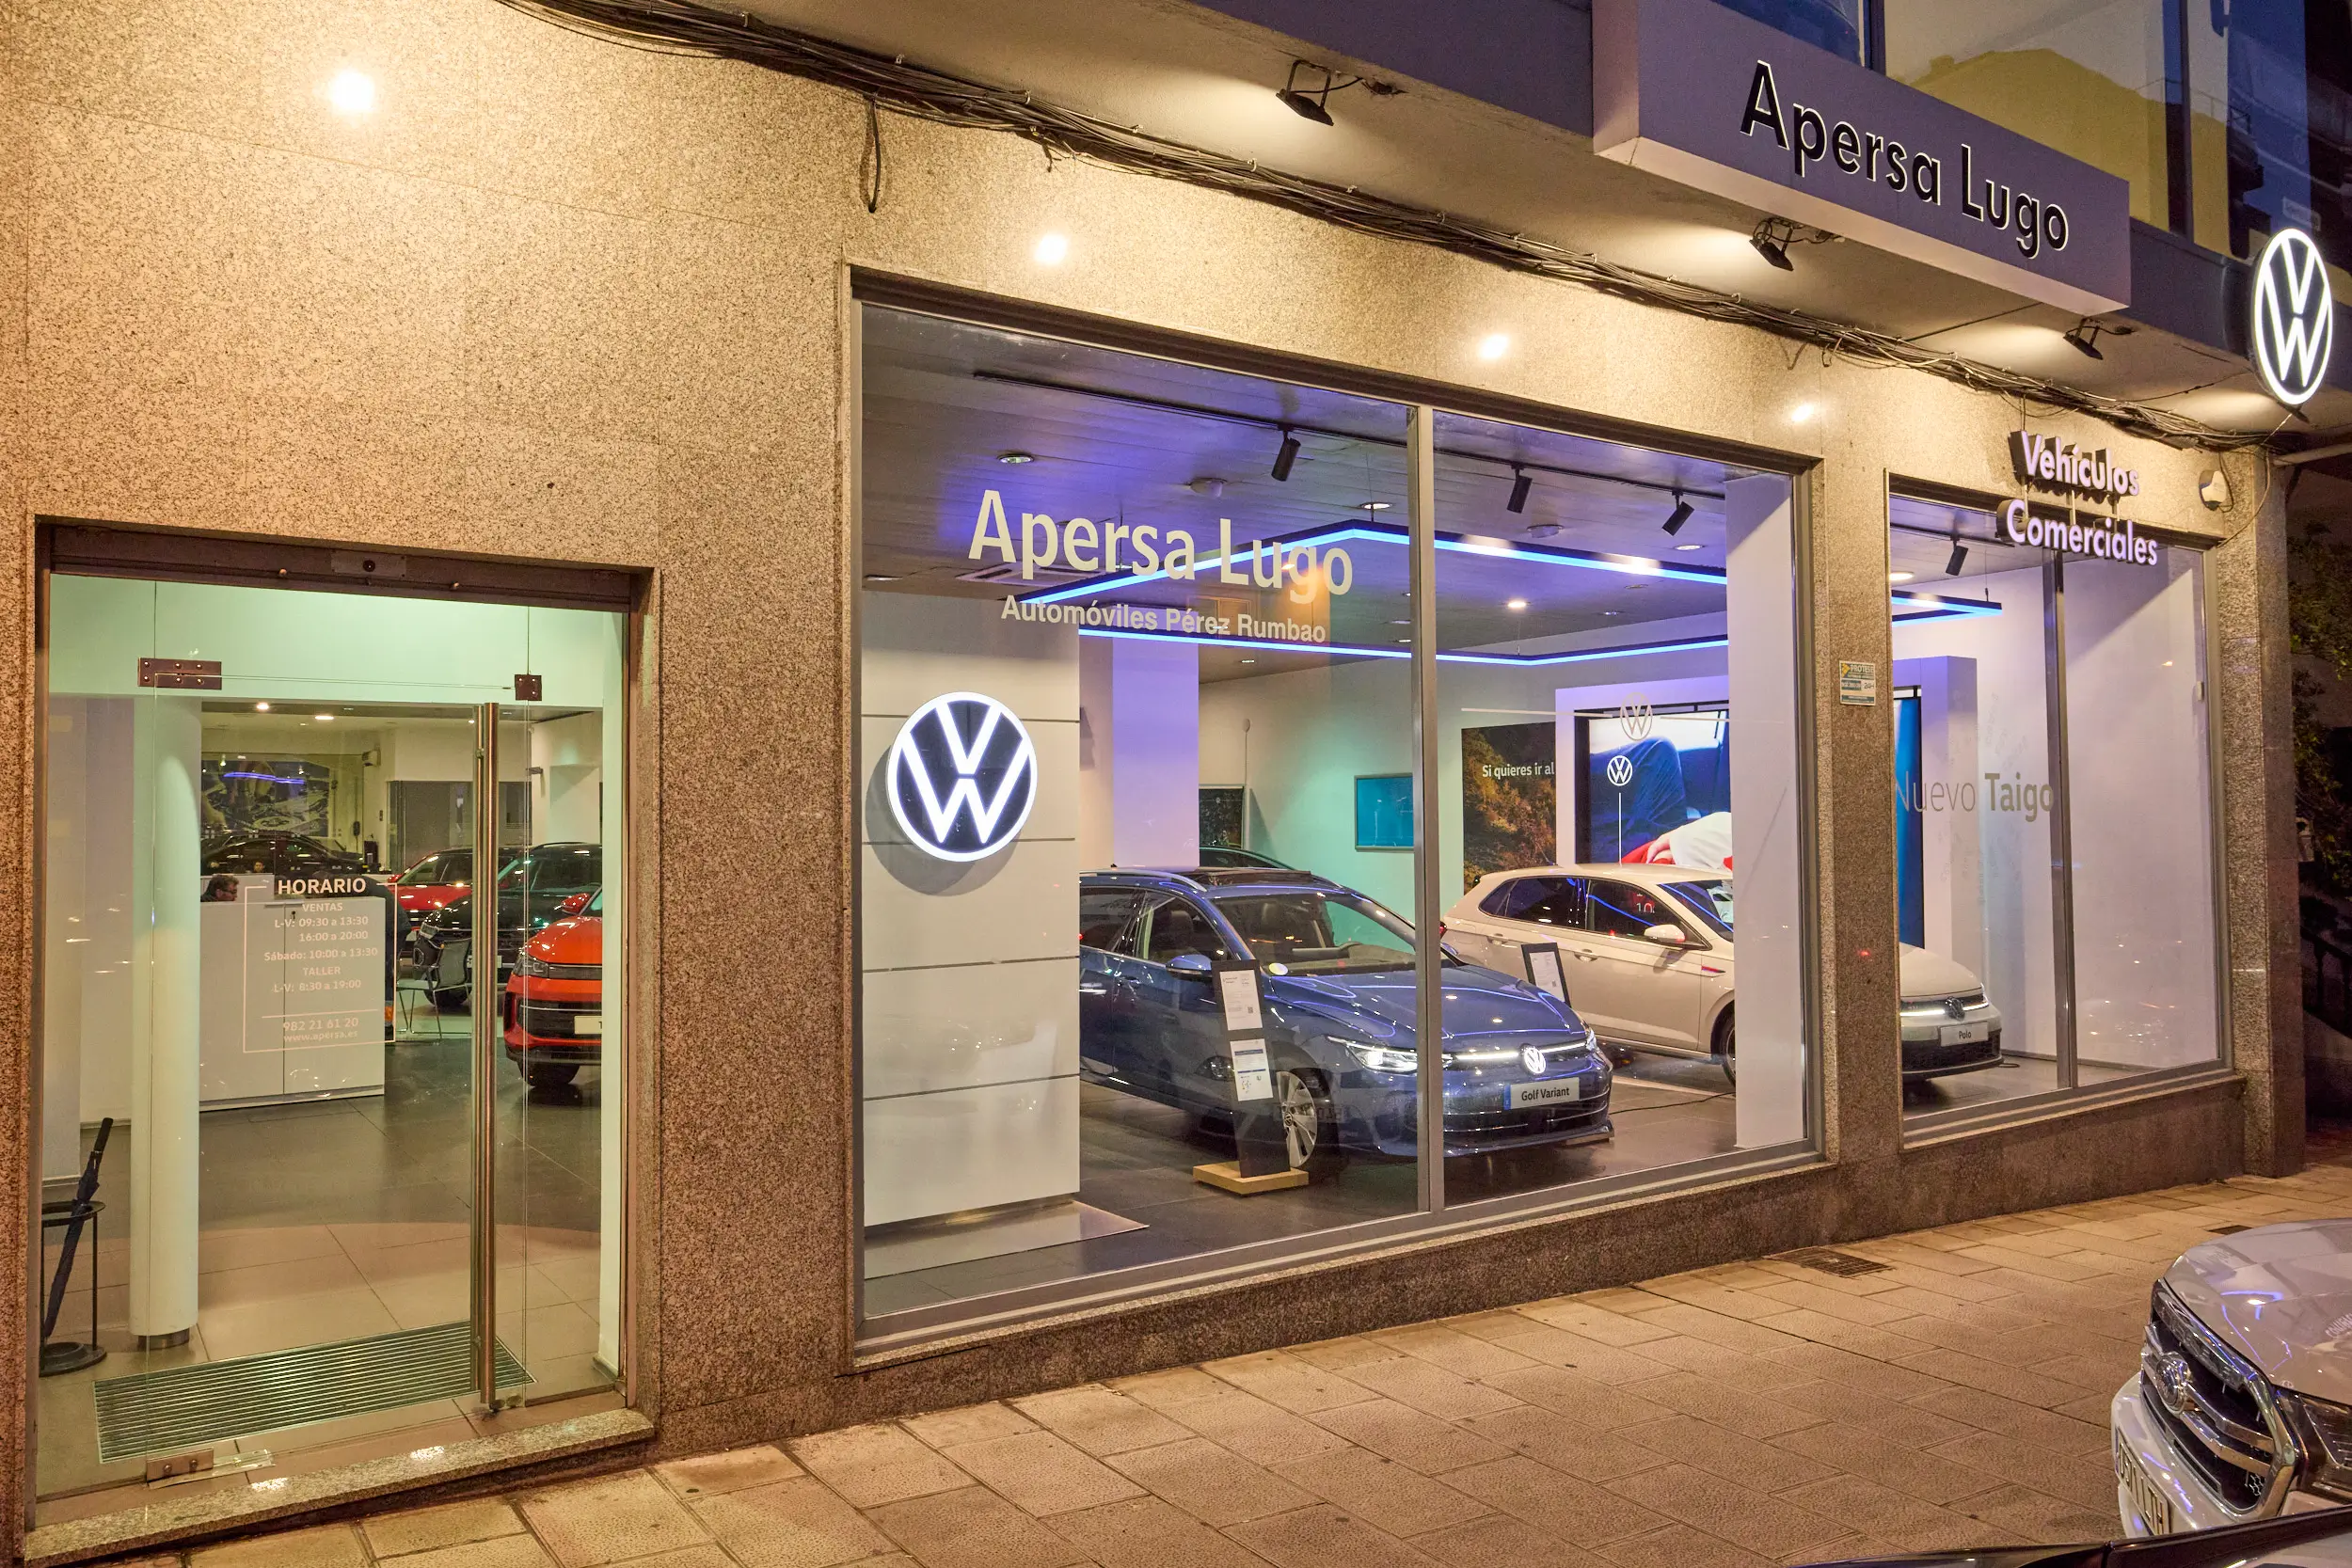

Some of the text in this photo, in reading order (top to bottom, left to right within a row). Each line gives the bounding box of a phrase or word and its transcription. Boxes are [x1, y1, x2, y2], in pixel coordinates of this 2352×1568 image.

[1739, 58, 2070, 260] Apersa Lugo
[2021, 430, 2140, 497] Vehículos
[2005, 498, 2159, 566] Comerciales
[968, 489, 1353, 605] Apersa Lugo
[1000, 594, 1326, 643] Automóviles Pérez Rumbao
[1482, 761, 1555, 780] Si quieres ir al
[1895, 770, 2055, 823] Nuevo Taigo
[278, 878, 366, 895] HORARIO
[302, 902, 343, 912] VENTAS
[298, 917, 329, 927] 09:30
[340, 915, 369, 926] 13:30
[299, 932, 328, 942] 16:00
[340, 930, 369, 941] 20:00
[263, 951, 307, 961] Sábado:
[310, 949, 339, 959] 10:00
[349, 947, 378, 958] 13:30
[302, 966, 342, 976] TALLER
[333, 979, 361, 990] 19:00
[283, 1021, 306, 1032] 982
[309, 1020, 323, 1030] 21
[344, 1017, 359, 1027] 20
[1958, 1030, 1972, 1039] Polo
[1521, 1087, 1570, 1101] Golf Variant
